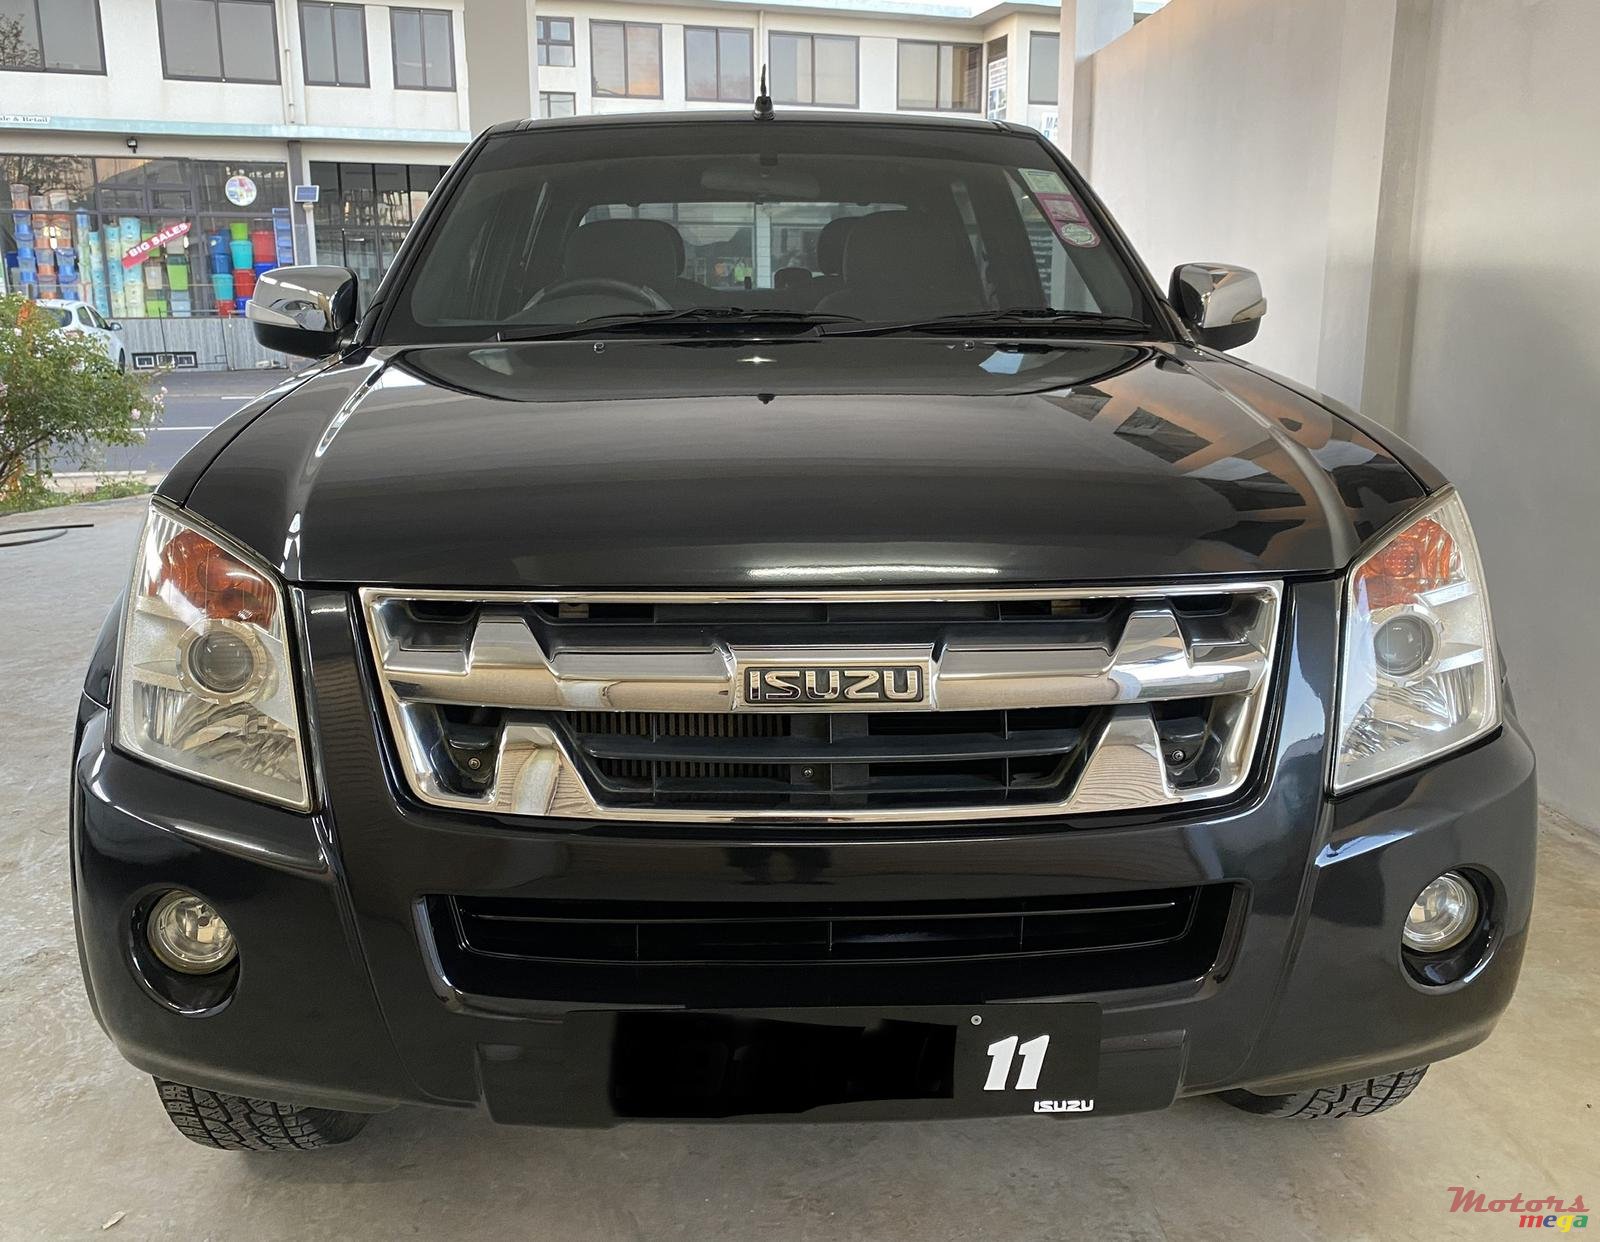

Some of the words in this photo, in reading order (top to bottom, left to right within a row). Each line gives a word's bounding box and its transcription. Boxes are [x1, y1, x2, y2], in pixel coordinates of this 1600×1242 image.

[128, 242, 150, 257] BIG
[151, 222, 188, 245] SALES
[750, 670, 917, 700] ISUZU
[983, 1035, 1050, 1090] 11
[1033, 1099, 1095, 1113] ISUZU
